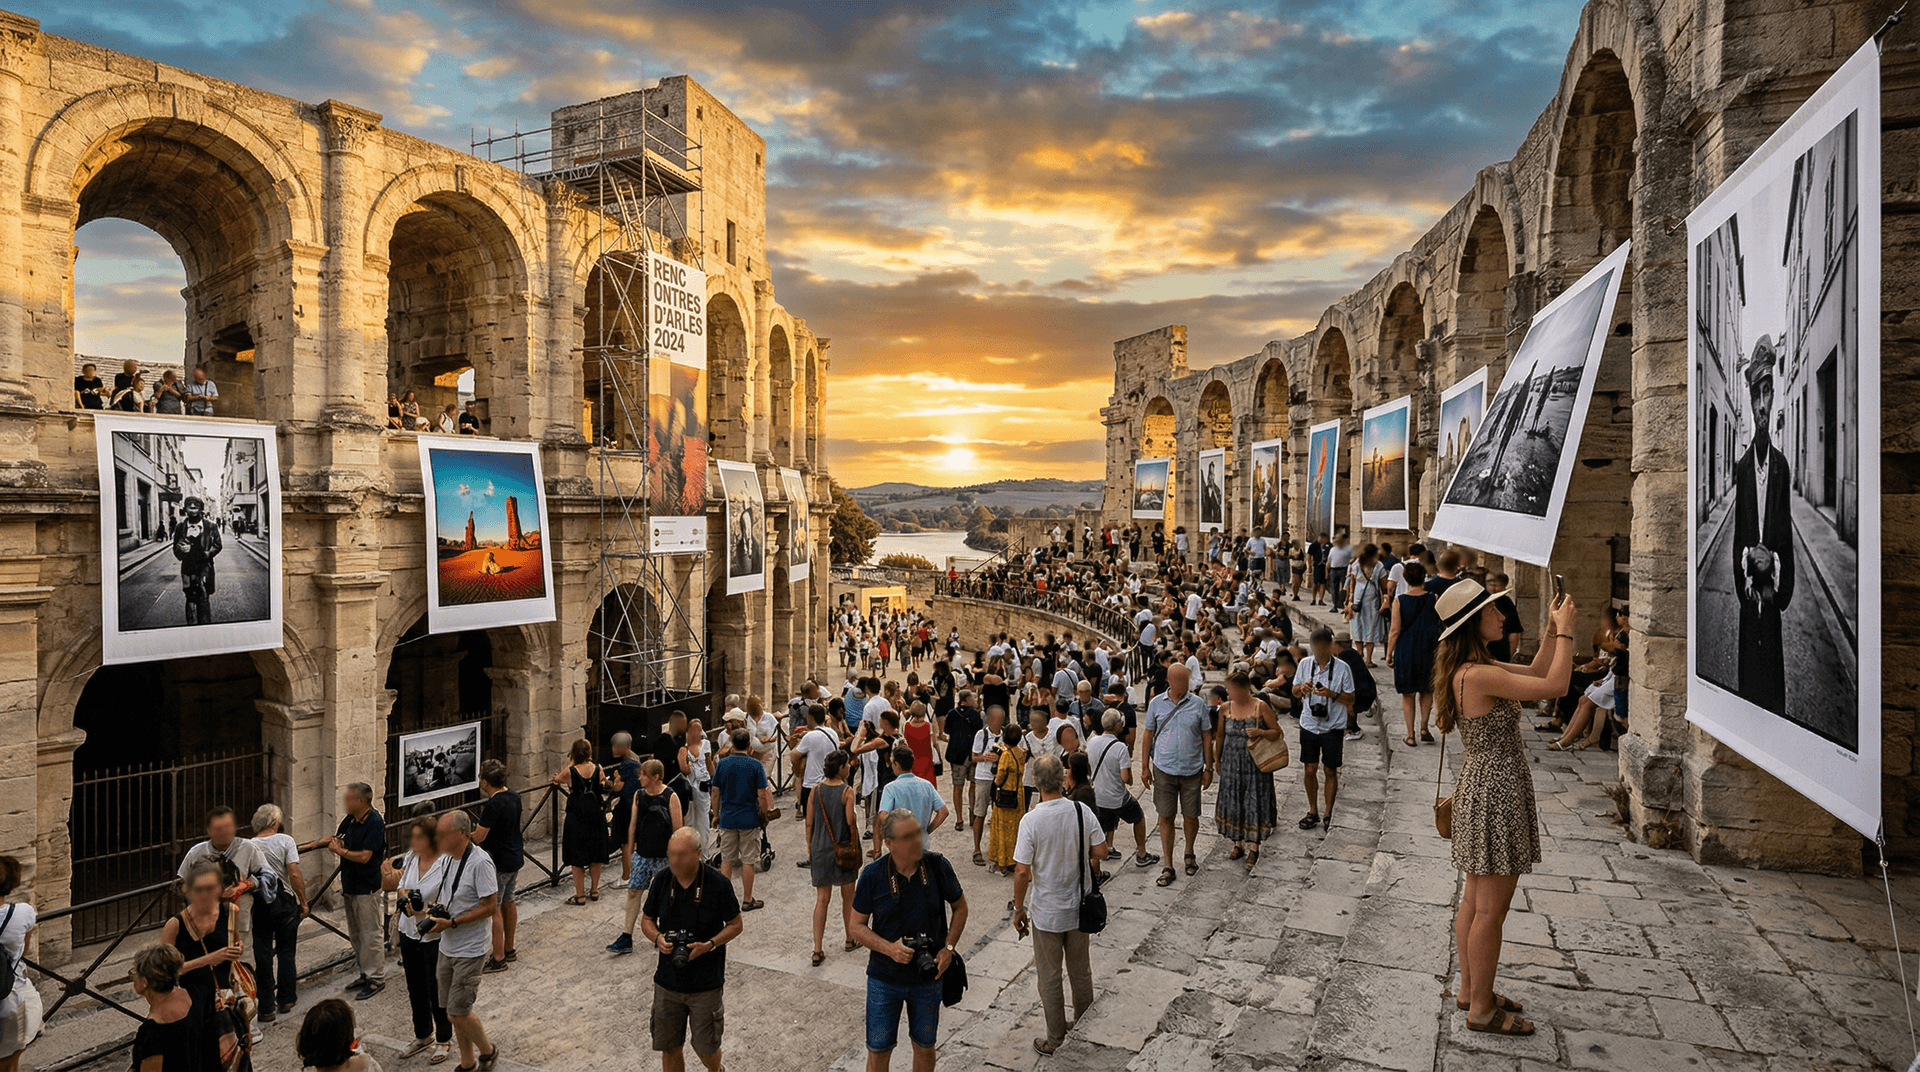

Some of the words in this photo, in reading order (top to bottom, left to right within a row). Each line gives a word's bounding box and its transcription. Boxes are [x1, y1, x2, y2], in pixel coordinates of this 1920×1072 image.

[653, 258, 687, 287] RENC
[653, 281, 701, 314] ONTRES
[654, 304, 703, 336] D'ARLES
[653, 327, 685, 353] 2024
